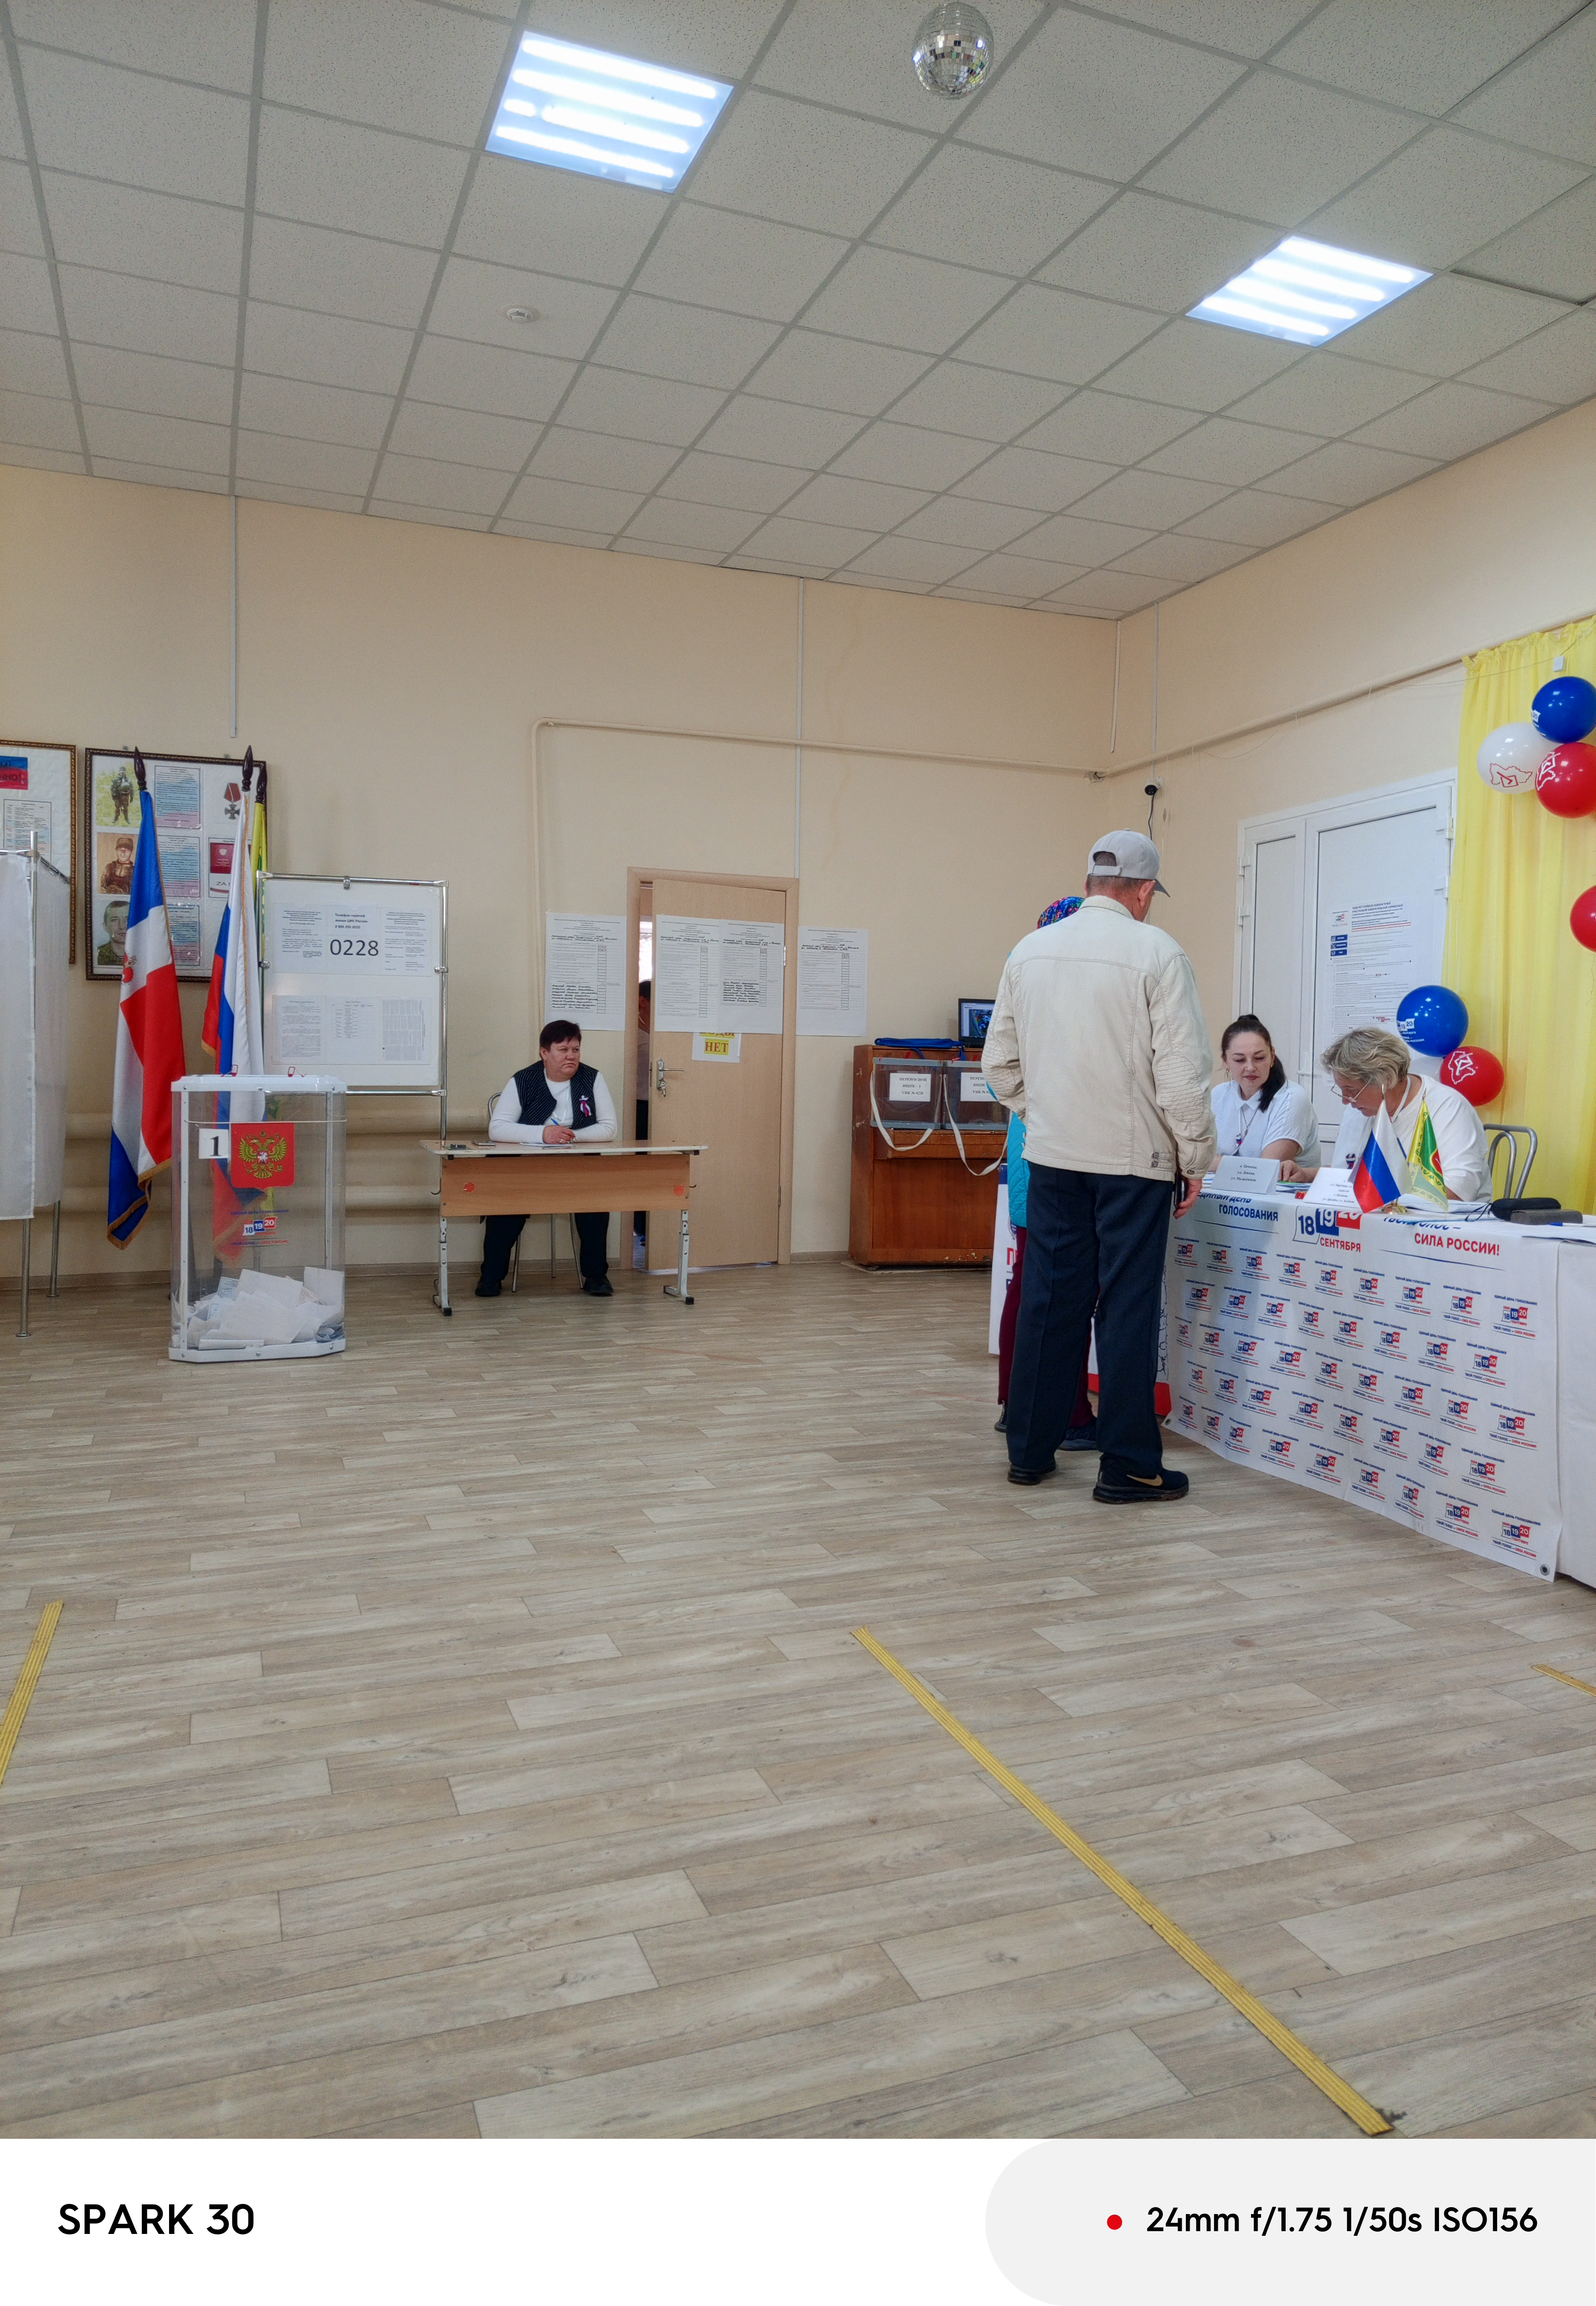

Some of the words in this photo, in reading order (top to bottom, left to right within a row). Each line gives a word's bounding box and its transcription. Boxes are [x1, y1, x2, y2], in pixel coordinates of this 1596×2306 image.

[330, 939, 379, 956] 0228
[705, 1041, 729, 1053] НЕТ
[210, 1136, 222, 1156] 1
[1219, 1204, 1278, 1221] ГОЛОСОВАНИЯ
[1298, 1215, 1315, 1236] 18
[1318, 1209, 1334, 1227] 19
[1320, 1237, 1361, 1252] СЕНТЯБРЯ
[1415, 1232, 1444, 1247] СИЛА
[1447, 1238, 1499, 1256] РОССИИ!
